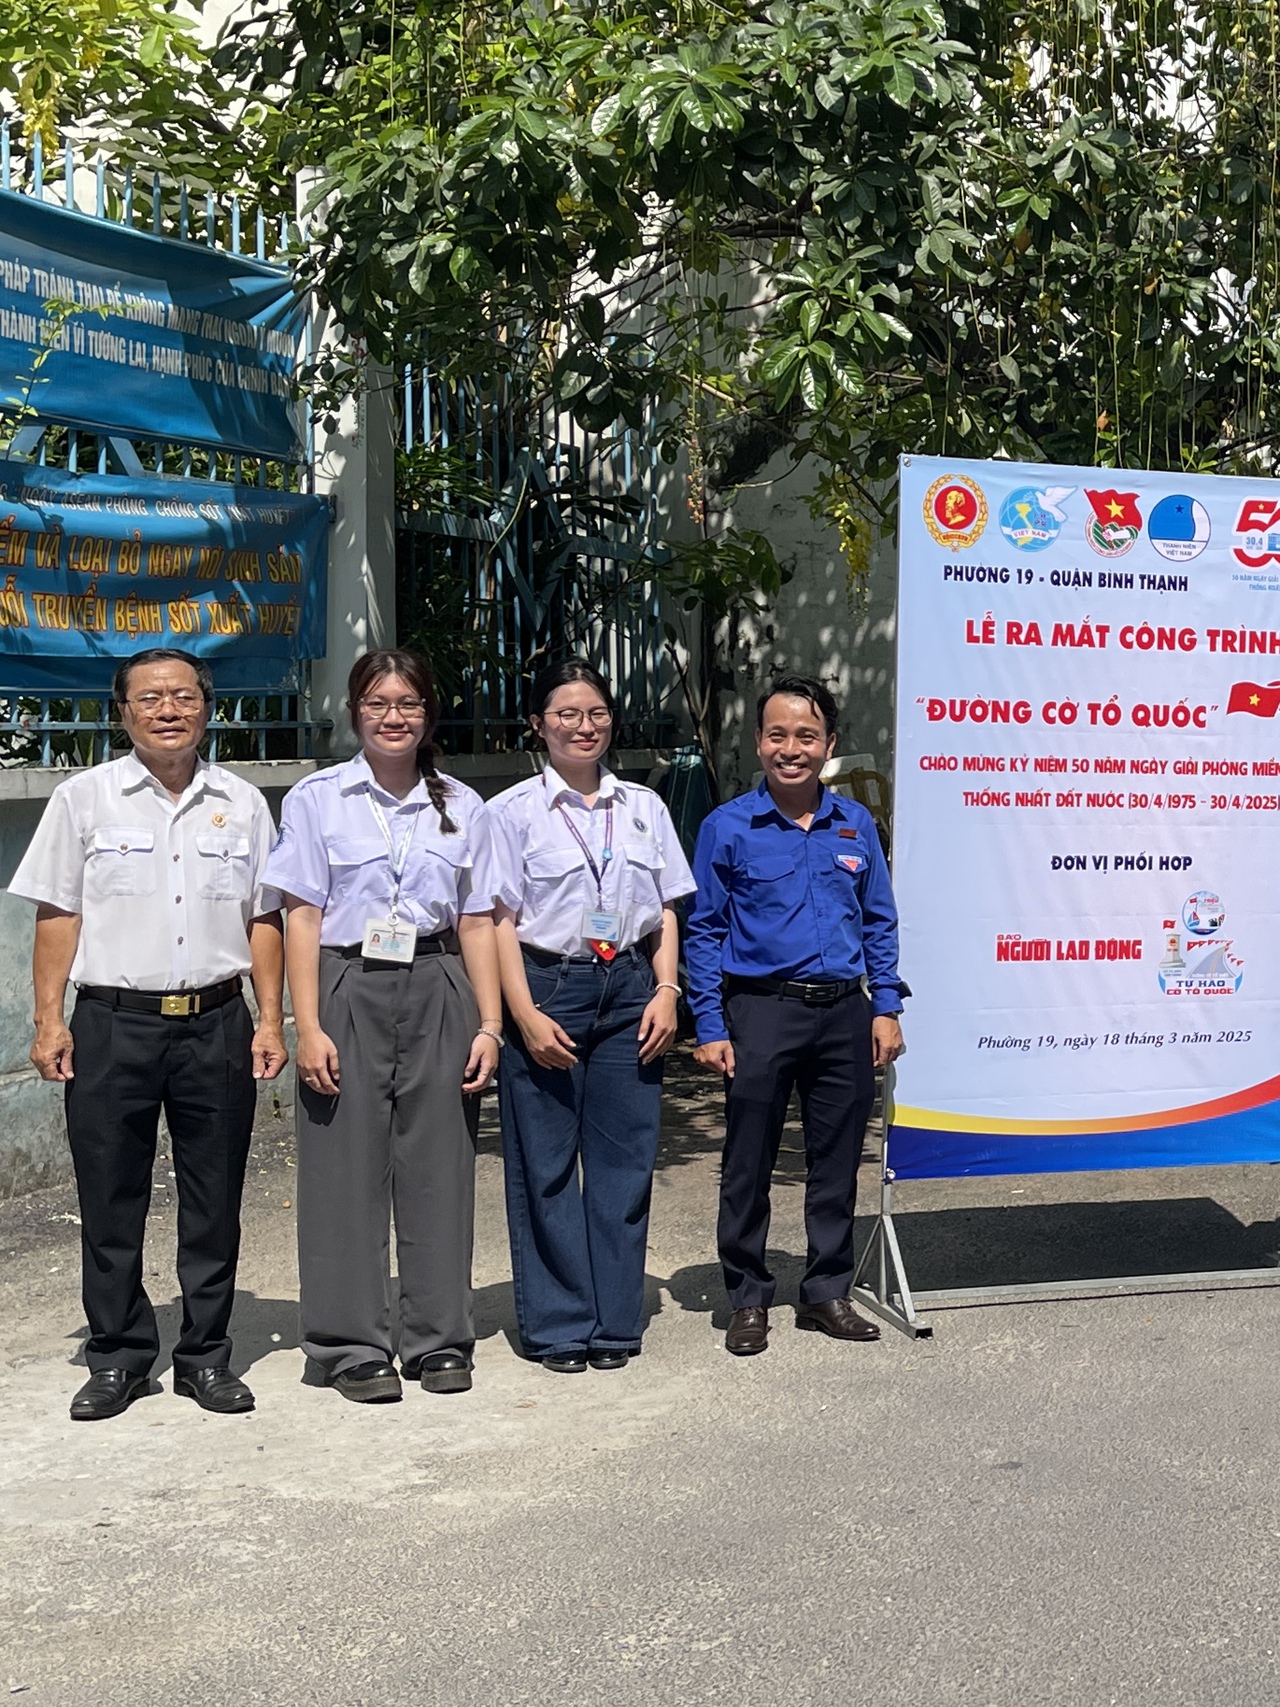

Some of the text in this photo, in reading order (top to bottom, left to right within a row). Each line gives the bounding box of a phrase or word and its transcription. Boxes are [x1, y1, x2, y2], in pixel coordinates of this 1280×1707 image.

[152, 344, 182, 379] HẠNH
[184, 351, 213, 383] PHÚC
[60, 491, 102, 513] ASEAN
[198, 499, 225, 520] SỐT
[1246, 536, 1263, 546] 30.4
[68, 535, 113, 578] LOẠI
[117, 529, 143, 576] BỎ
[147, 543, 194, 579] NGAY
[225, 550, 263, 583] SINH
[943, 562, 1010, 584] PHƯỜNG
[1016, 569, 1034, 585] 19
[1050, 567, 1093, 592] QUẬN
[1097, 568, 1134, 589] BÌNH
[1138, 573, 1189, 595] THẠNH
[31, 582, 108, 632] TRUYỀN
[114, 589, 163, 639] BỆNH
[167, 590, 202, 634] SỐT
[205, 590, 253, 636] XUẤT
[966, 610, 996, 645] LỄ
[1006, 621, 1043, 646] RA
[1051, 614, 1110, 649] MẮT
[1119, 620, 1198, 652] CÔNG
[1042, 696, 1080, 726] CỜ
[1087, 694, 1122, 727] TỔ
[919, 753, 959, 771] CHÀO
[962, 754, 1006, 772] MỪNG
[1009, 753, 1030, 773] KỶ
[1033, 755, 1068, 777] NIỆM
[1072, 759, 1090, 773] 50
[1094, 757, 1127, 774] NĂM
[1130, 757, 1169, 775] NGÀY
[1173, 756, 1199, 776] GIẢI
[1202, 759, 1249, 777] PHÓNG
[962, 787, 1011, 807] THỐNG
[1014, 788, 1052, 808] NHẤT
[1055, 788, 1083, 808] ĐẤT
[1086, 790, 1125, 808] NƯỚC
[1051, 855, 1087, 871] ĐƠN
[1092, 855, 1108, 875] VỊ
[1114, 851, 1153, 871] PHỐI
[1056, 940, 1090, 961] LAO
[1094, 938, 1143, 961] ĐỘNG
[977, 1030, 1253, 1051] Phường 19, ngày 18 tháng 3 năm 2025
